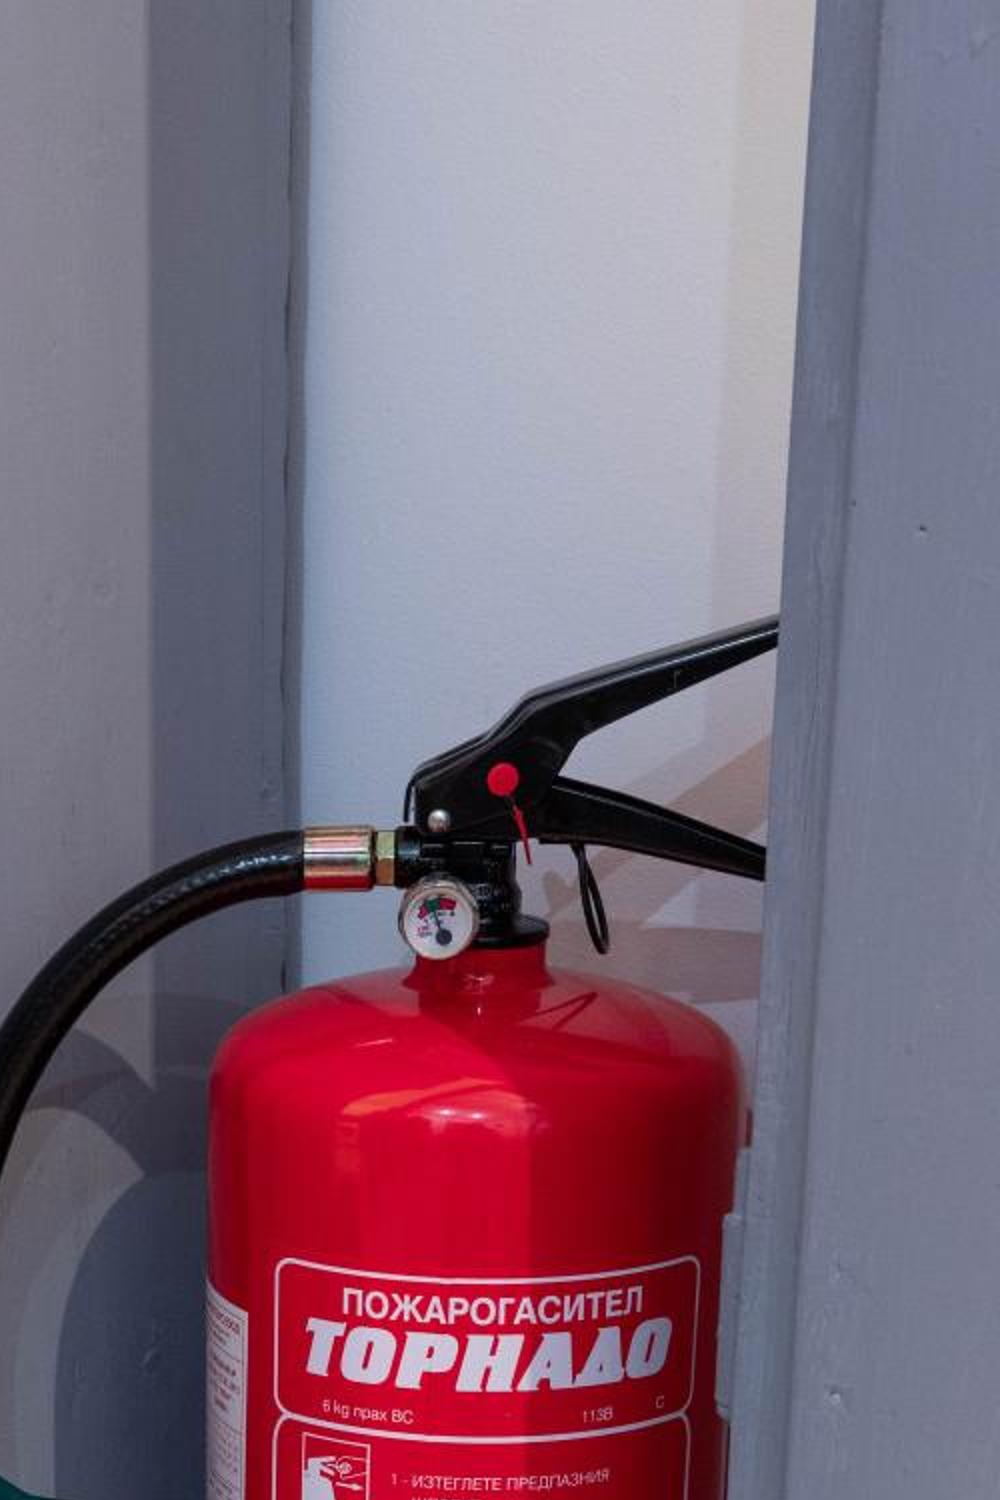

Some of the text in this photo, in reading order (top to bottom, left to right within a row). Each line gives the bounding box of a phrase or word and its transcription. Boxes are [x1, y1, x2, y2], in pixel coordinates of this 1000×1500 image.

[343, 1285, 644, 1326] ПОЖАРОГАСИТЕЛ
[305, 1316, 673, 1393] ТОРНАДО
[323, 1400, 331, 1412] 6
[334, 1401, 349, 1417] kg
[353, 1404, 387, 1421] прах
[391, 1473, 397, 1486] 1
[411, 1475, 502, 1491] ИЗТЕГЛЕТЕ
[506, 1468, 610, 1492] ПРЕДПАЗНИЯ
